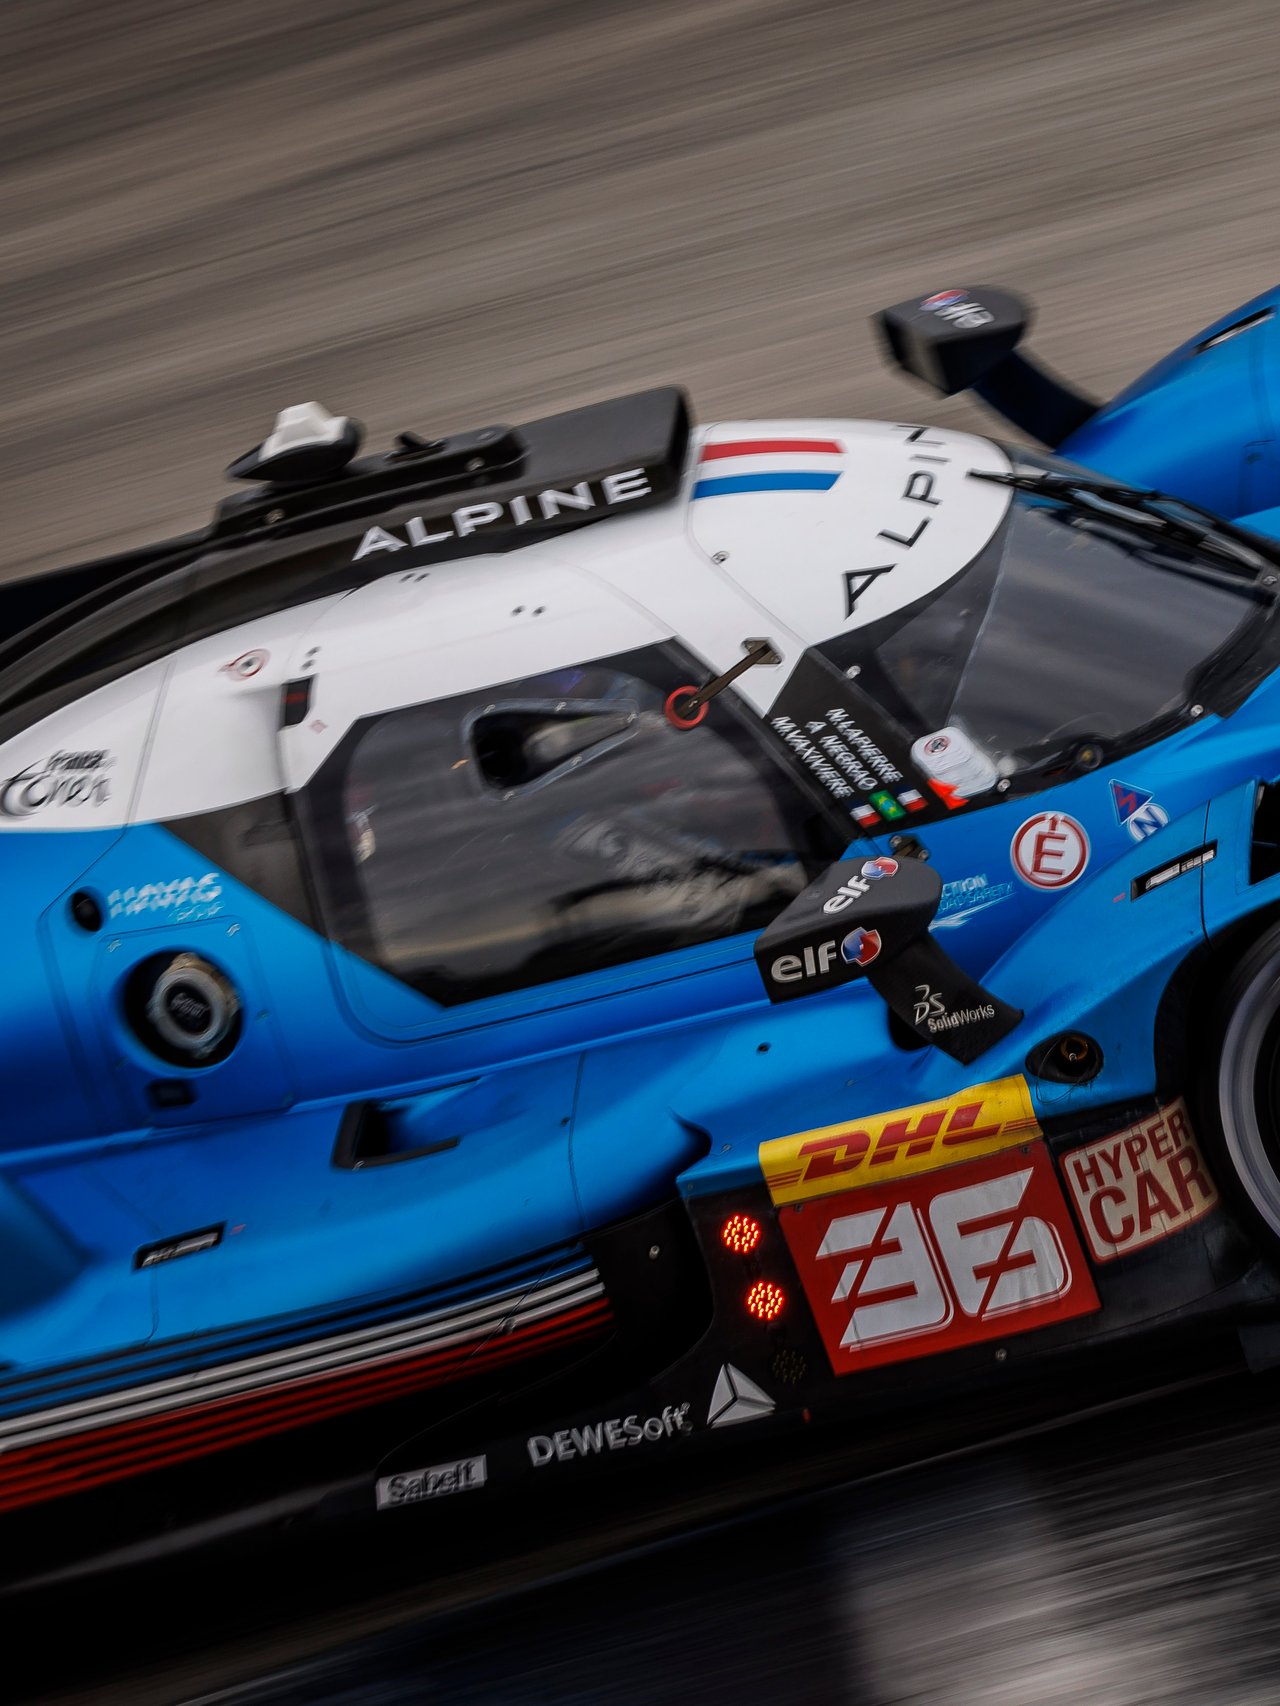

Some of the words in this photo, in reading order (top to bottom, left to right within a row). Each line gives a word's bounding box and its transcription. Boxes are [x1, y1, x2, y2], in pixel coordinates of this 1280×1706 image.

[351, 467, 653, 562] ALPINE
[841, 424, 951, 621] ALPIN
[1030, 829, 1067, 876] E
[823, 875, 871, 915] elf
[940, 873, 988, 898] CTION
[770, 939, 837, 984] elf
[927, 1004, 995, 1033] SolidWorks
[799, 1101, 1000, 1184] DHL
[1072, 1109, 1192, 1197] HYPER
[1089, 1147, 1214, 1245] CAR
[815, 1166, 1073, 1352] 36
[387, 1459, 478, 1505] Sabelt
